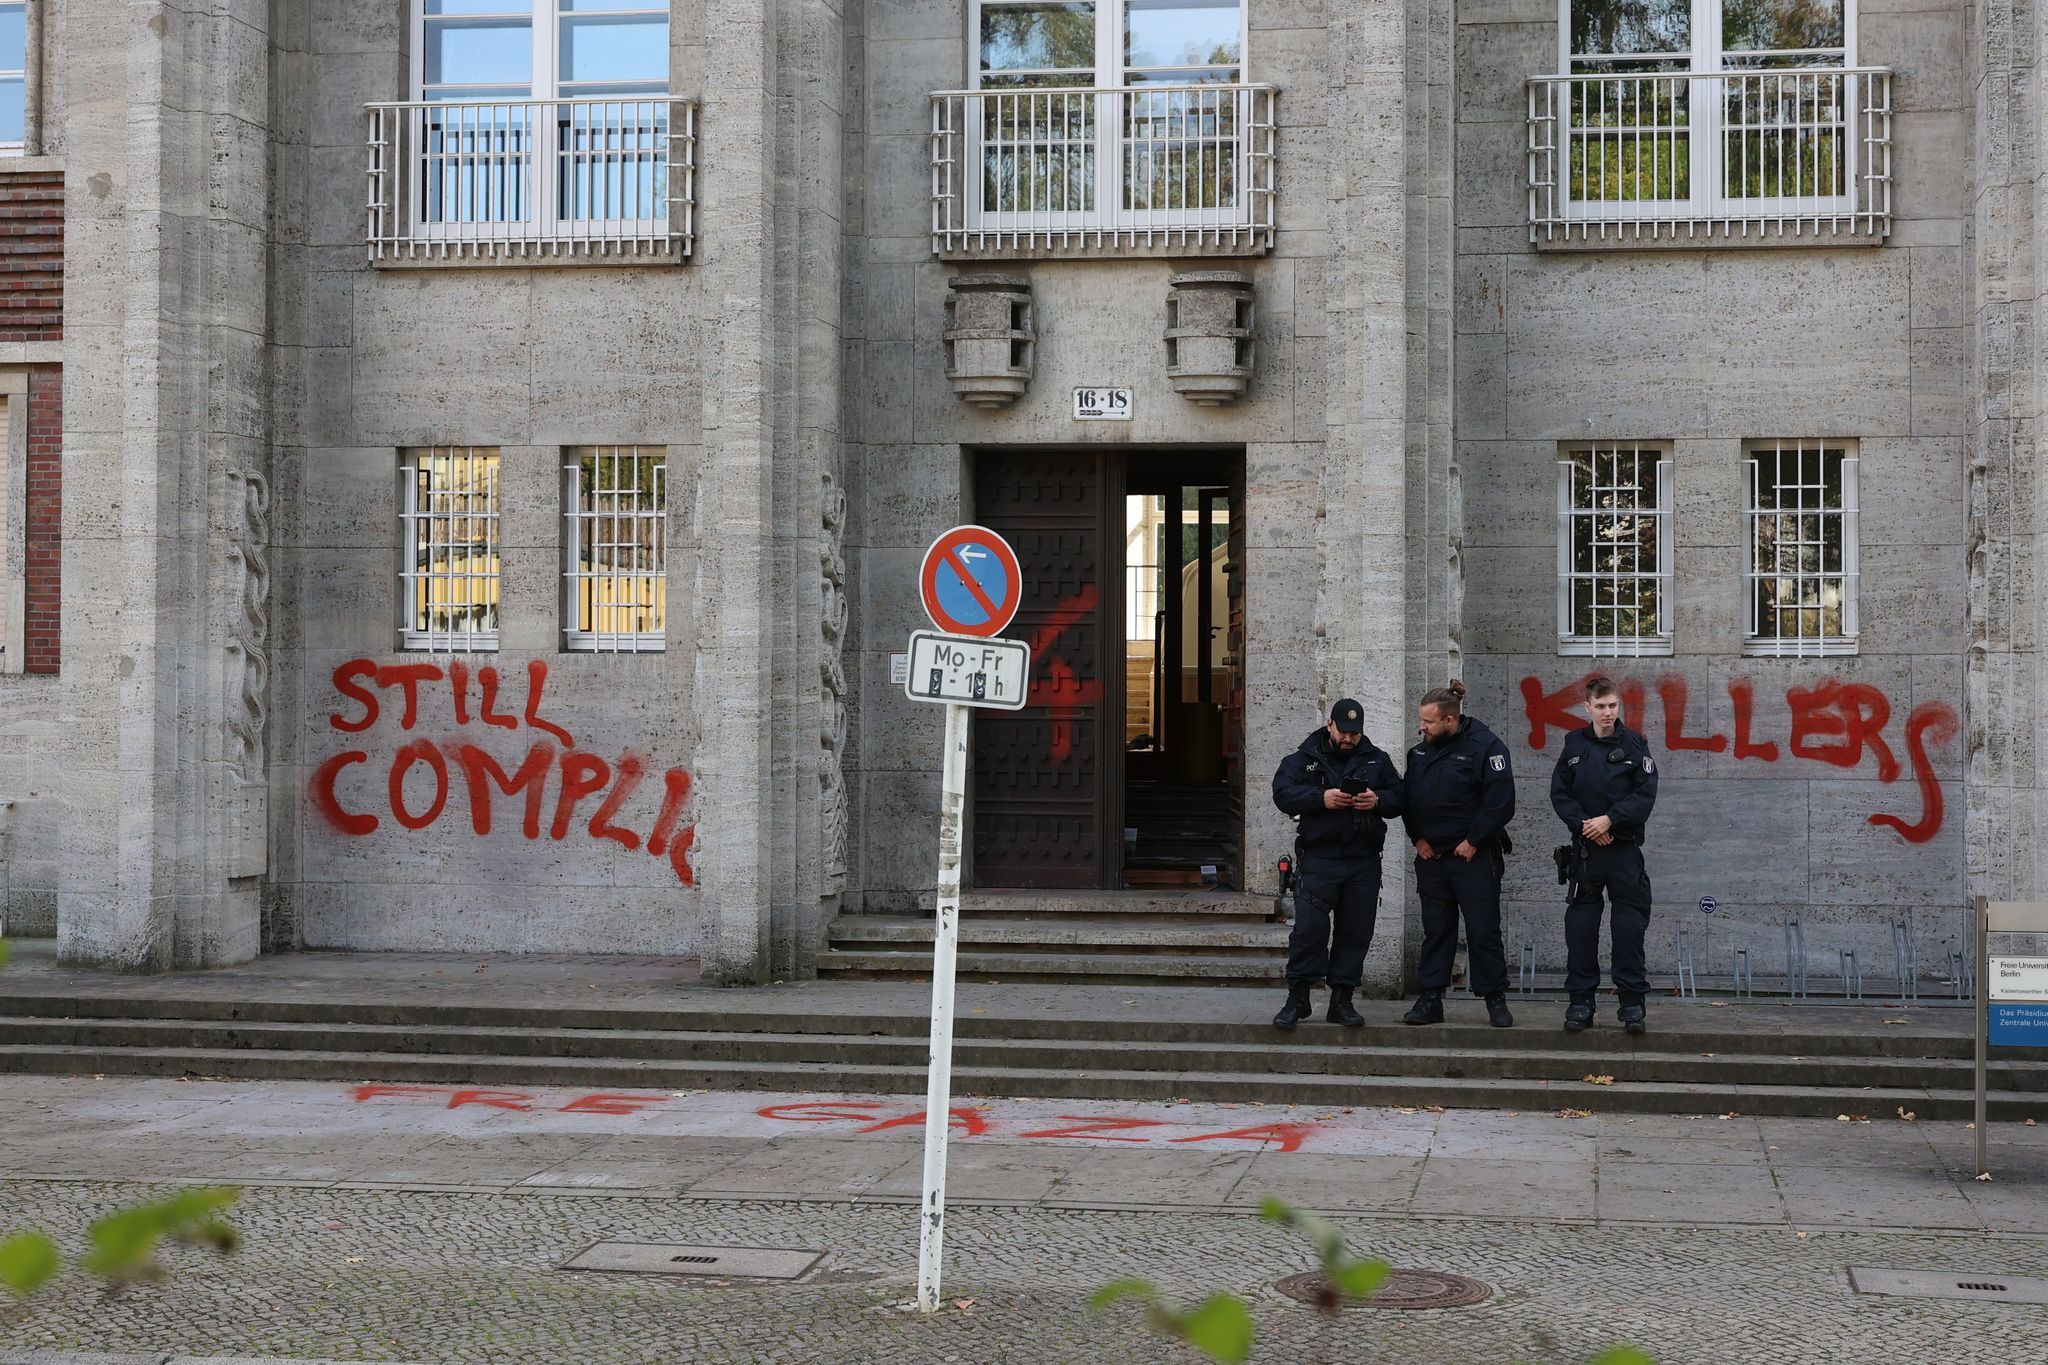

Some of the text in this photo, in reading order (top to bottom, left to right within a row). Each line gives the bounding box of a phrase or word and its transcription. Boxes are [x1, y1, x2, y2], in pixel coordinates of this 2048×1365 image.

[1077, 390, 1096, 408] 16
[1107, 390, 1127, 408] 18
[330, 658, 574, 748] STILL
[1520, 671, 1957, 843] KILLERS
[2000, 1018, 2030, 1026] Zentrale
